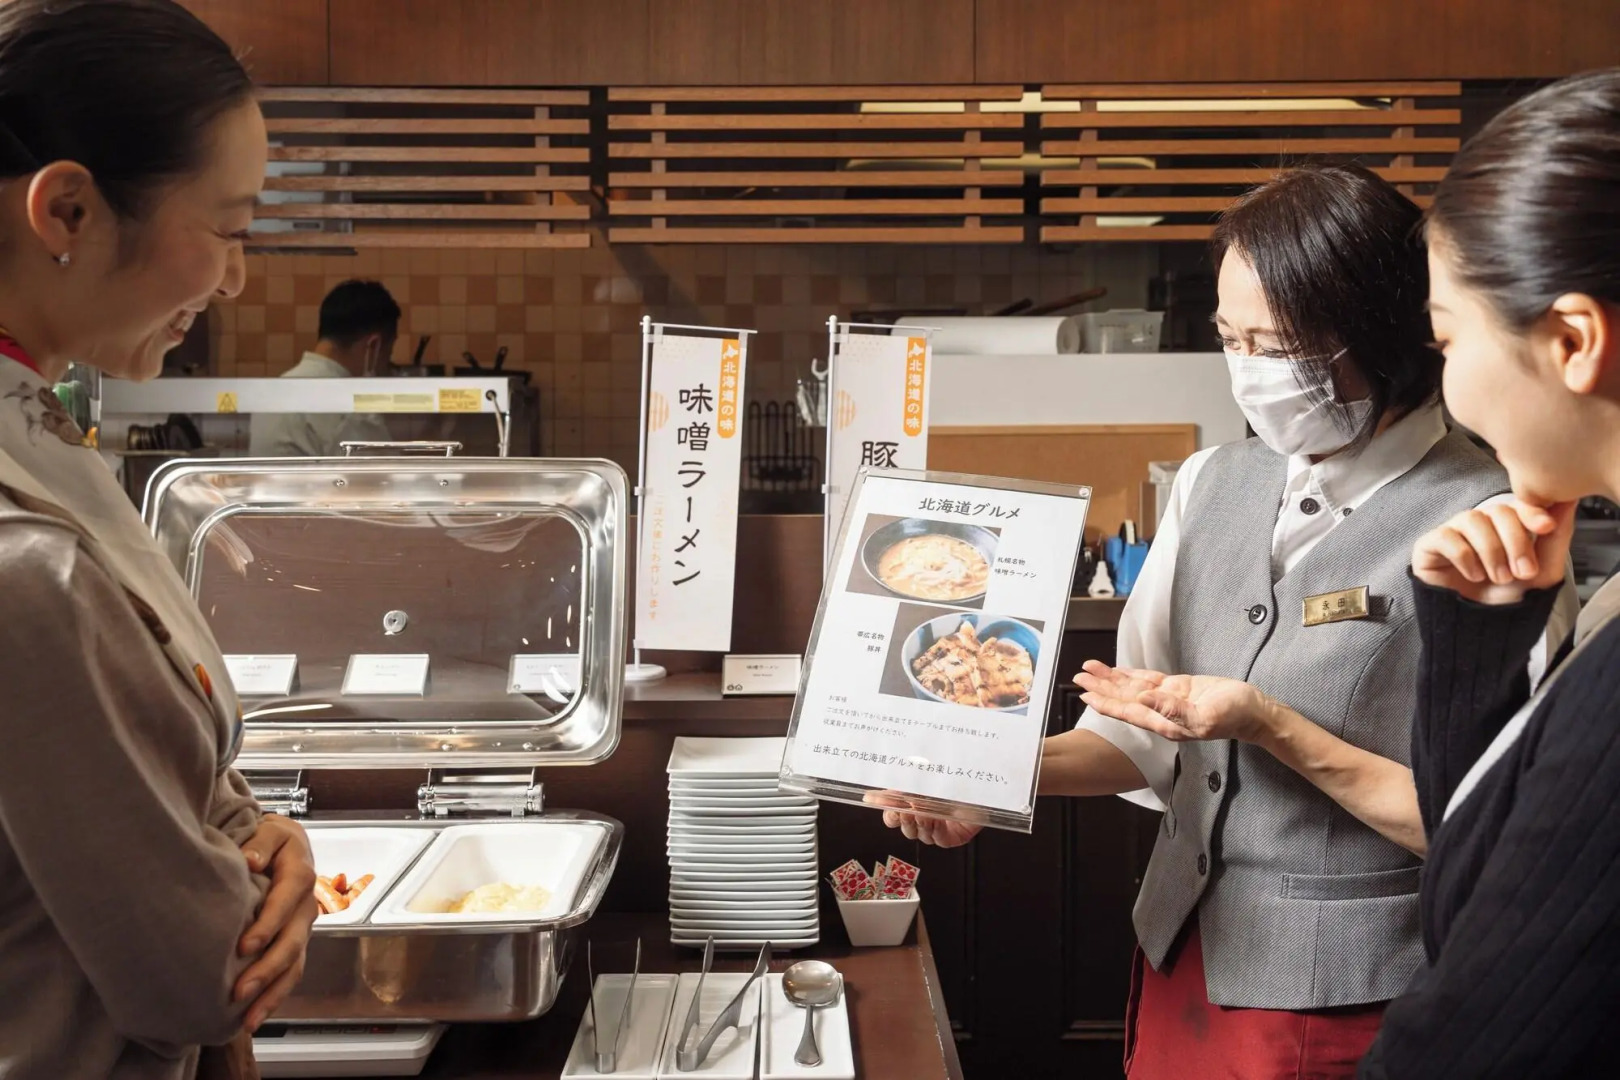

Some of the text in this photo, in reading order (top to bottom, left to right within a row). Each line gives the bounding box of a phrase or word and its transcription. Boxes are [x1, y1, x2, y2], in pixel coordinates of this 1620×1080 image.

[719, 361, 737, 432] 北海道の味
[906, 359, 924, 430] 北海道の味
[671, 382, 714, 588] 味噌ラーメン
[860, 440, 900, 469] 豚
[918, 496, 1023, 520] 北海道グルメ
